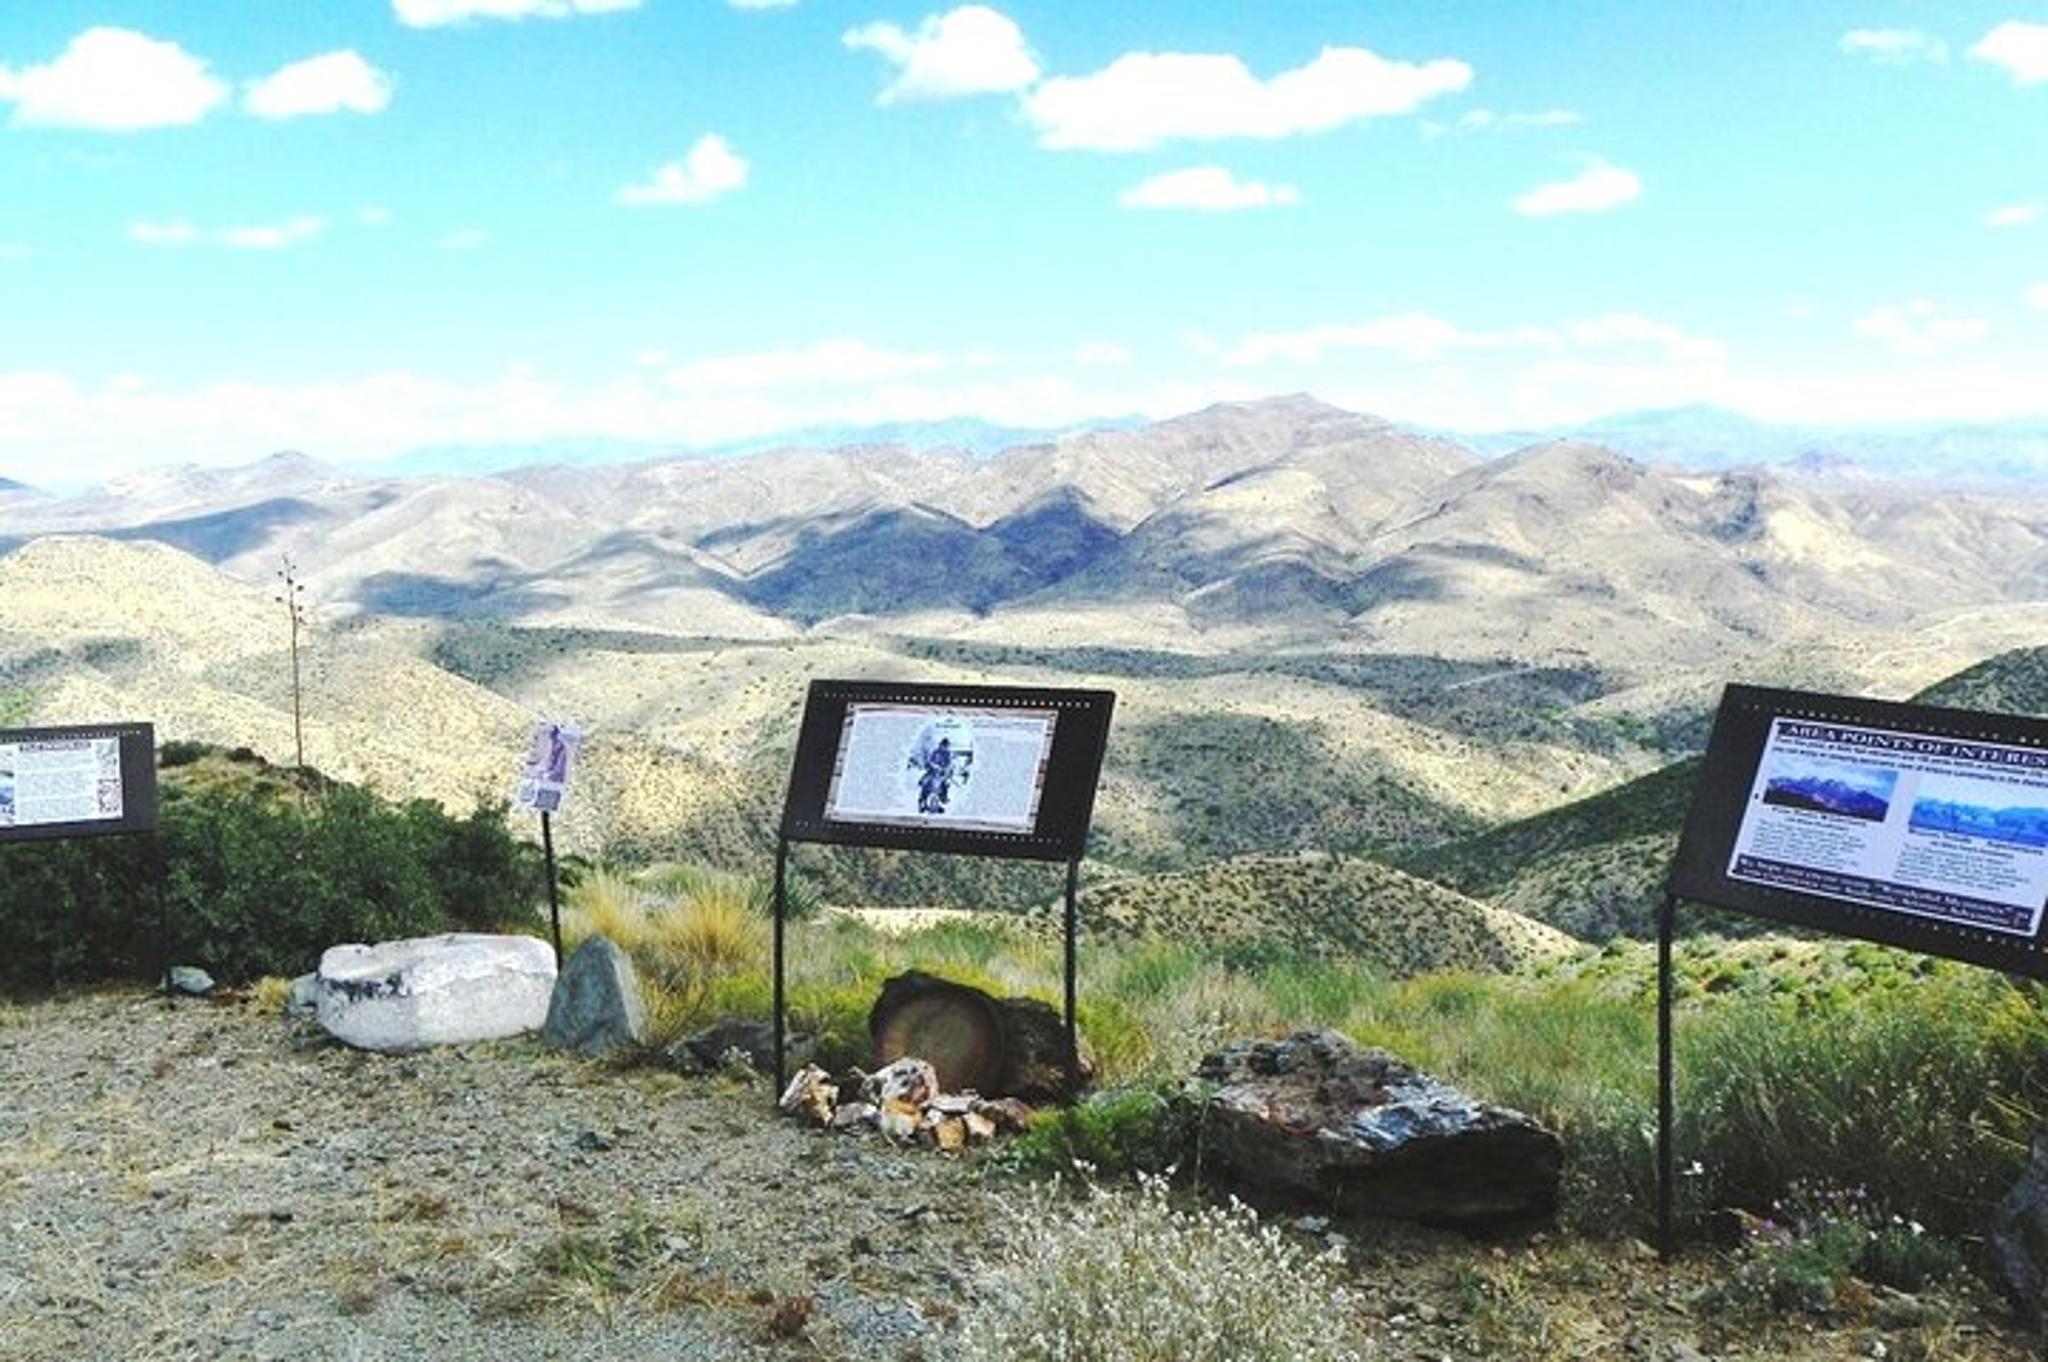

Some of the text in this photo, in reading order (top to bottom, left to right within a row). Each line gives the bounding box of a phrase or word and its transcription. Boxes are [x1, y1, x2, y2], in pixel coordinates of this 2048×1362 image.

[1787, 725, 1836, 740] AREA
[1839, 731, 1915, 748] POINTS
[1918, 741, 1946, 755] OF
